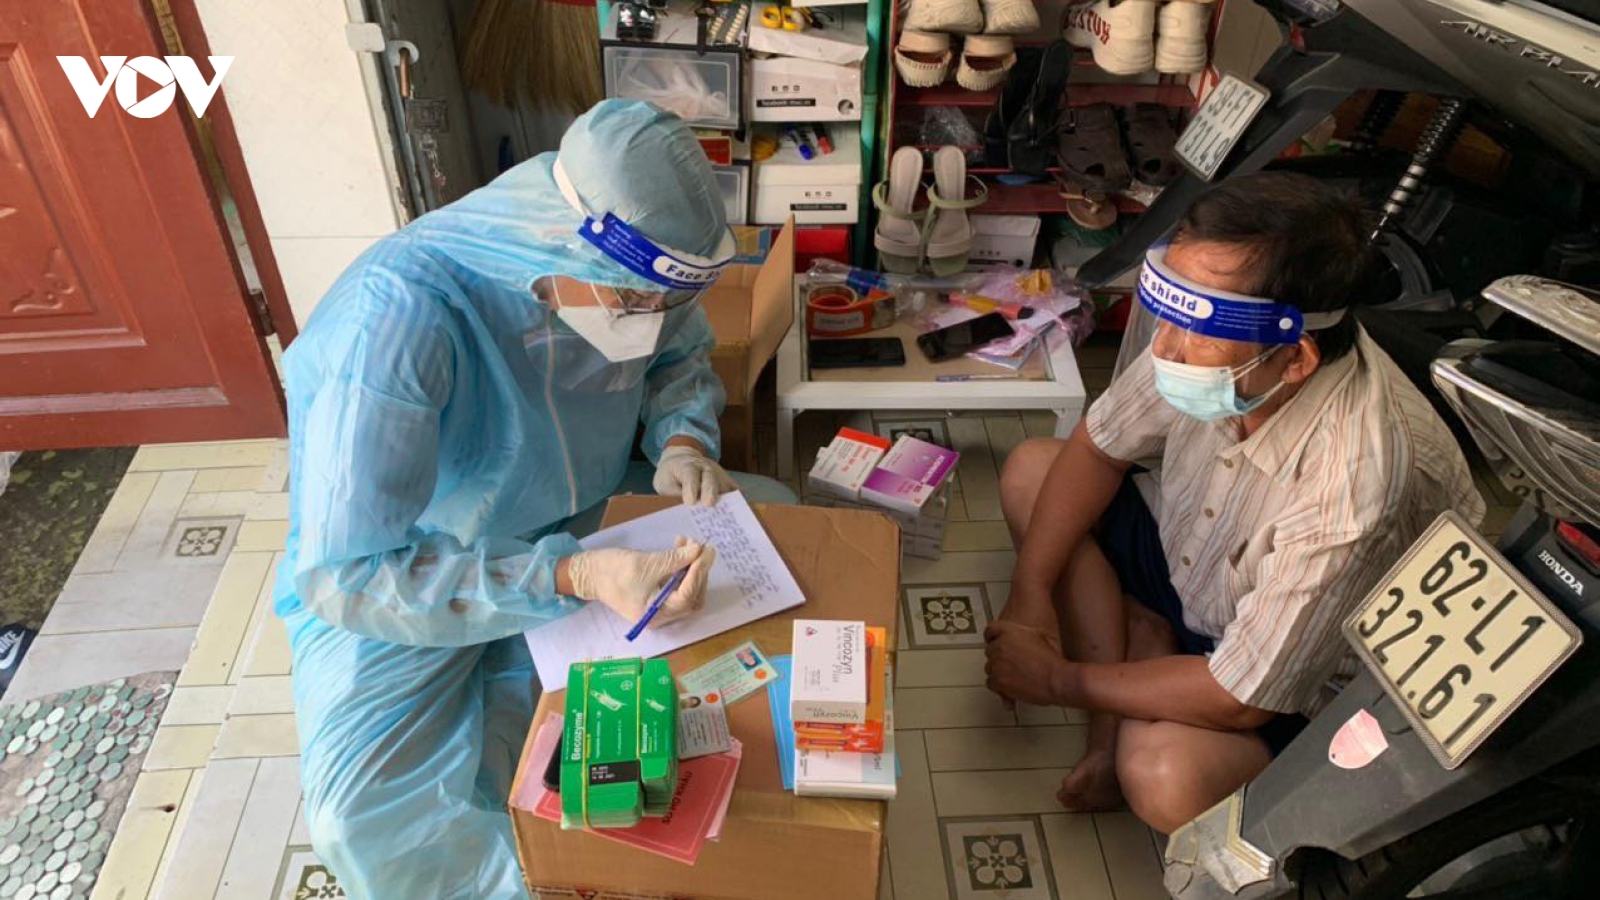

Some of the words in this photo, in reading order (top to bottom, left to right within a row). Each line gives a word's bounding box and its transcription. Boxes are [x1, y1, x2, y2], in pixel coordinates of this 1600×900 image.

[666, 263, 702, 281] Face
[1150, 280, 1198, 313] shield
[1537, 550, 1585, 596] HONDA
[1420, 541, 1546, 673] 62-L1
[840, 625, 854, 675] Vincozyn
[1359, 587, 1497, 748] 321.61
[571, 712, 584, 760] Becozyme
